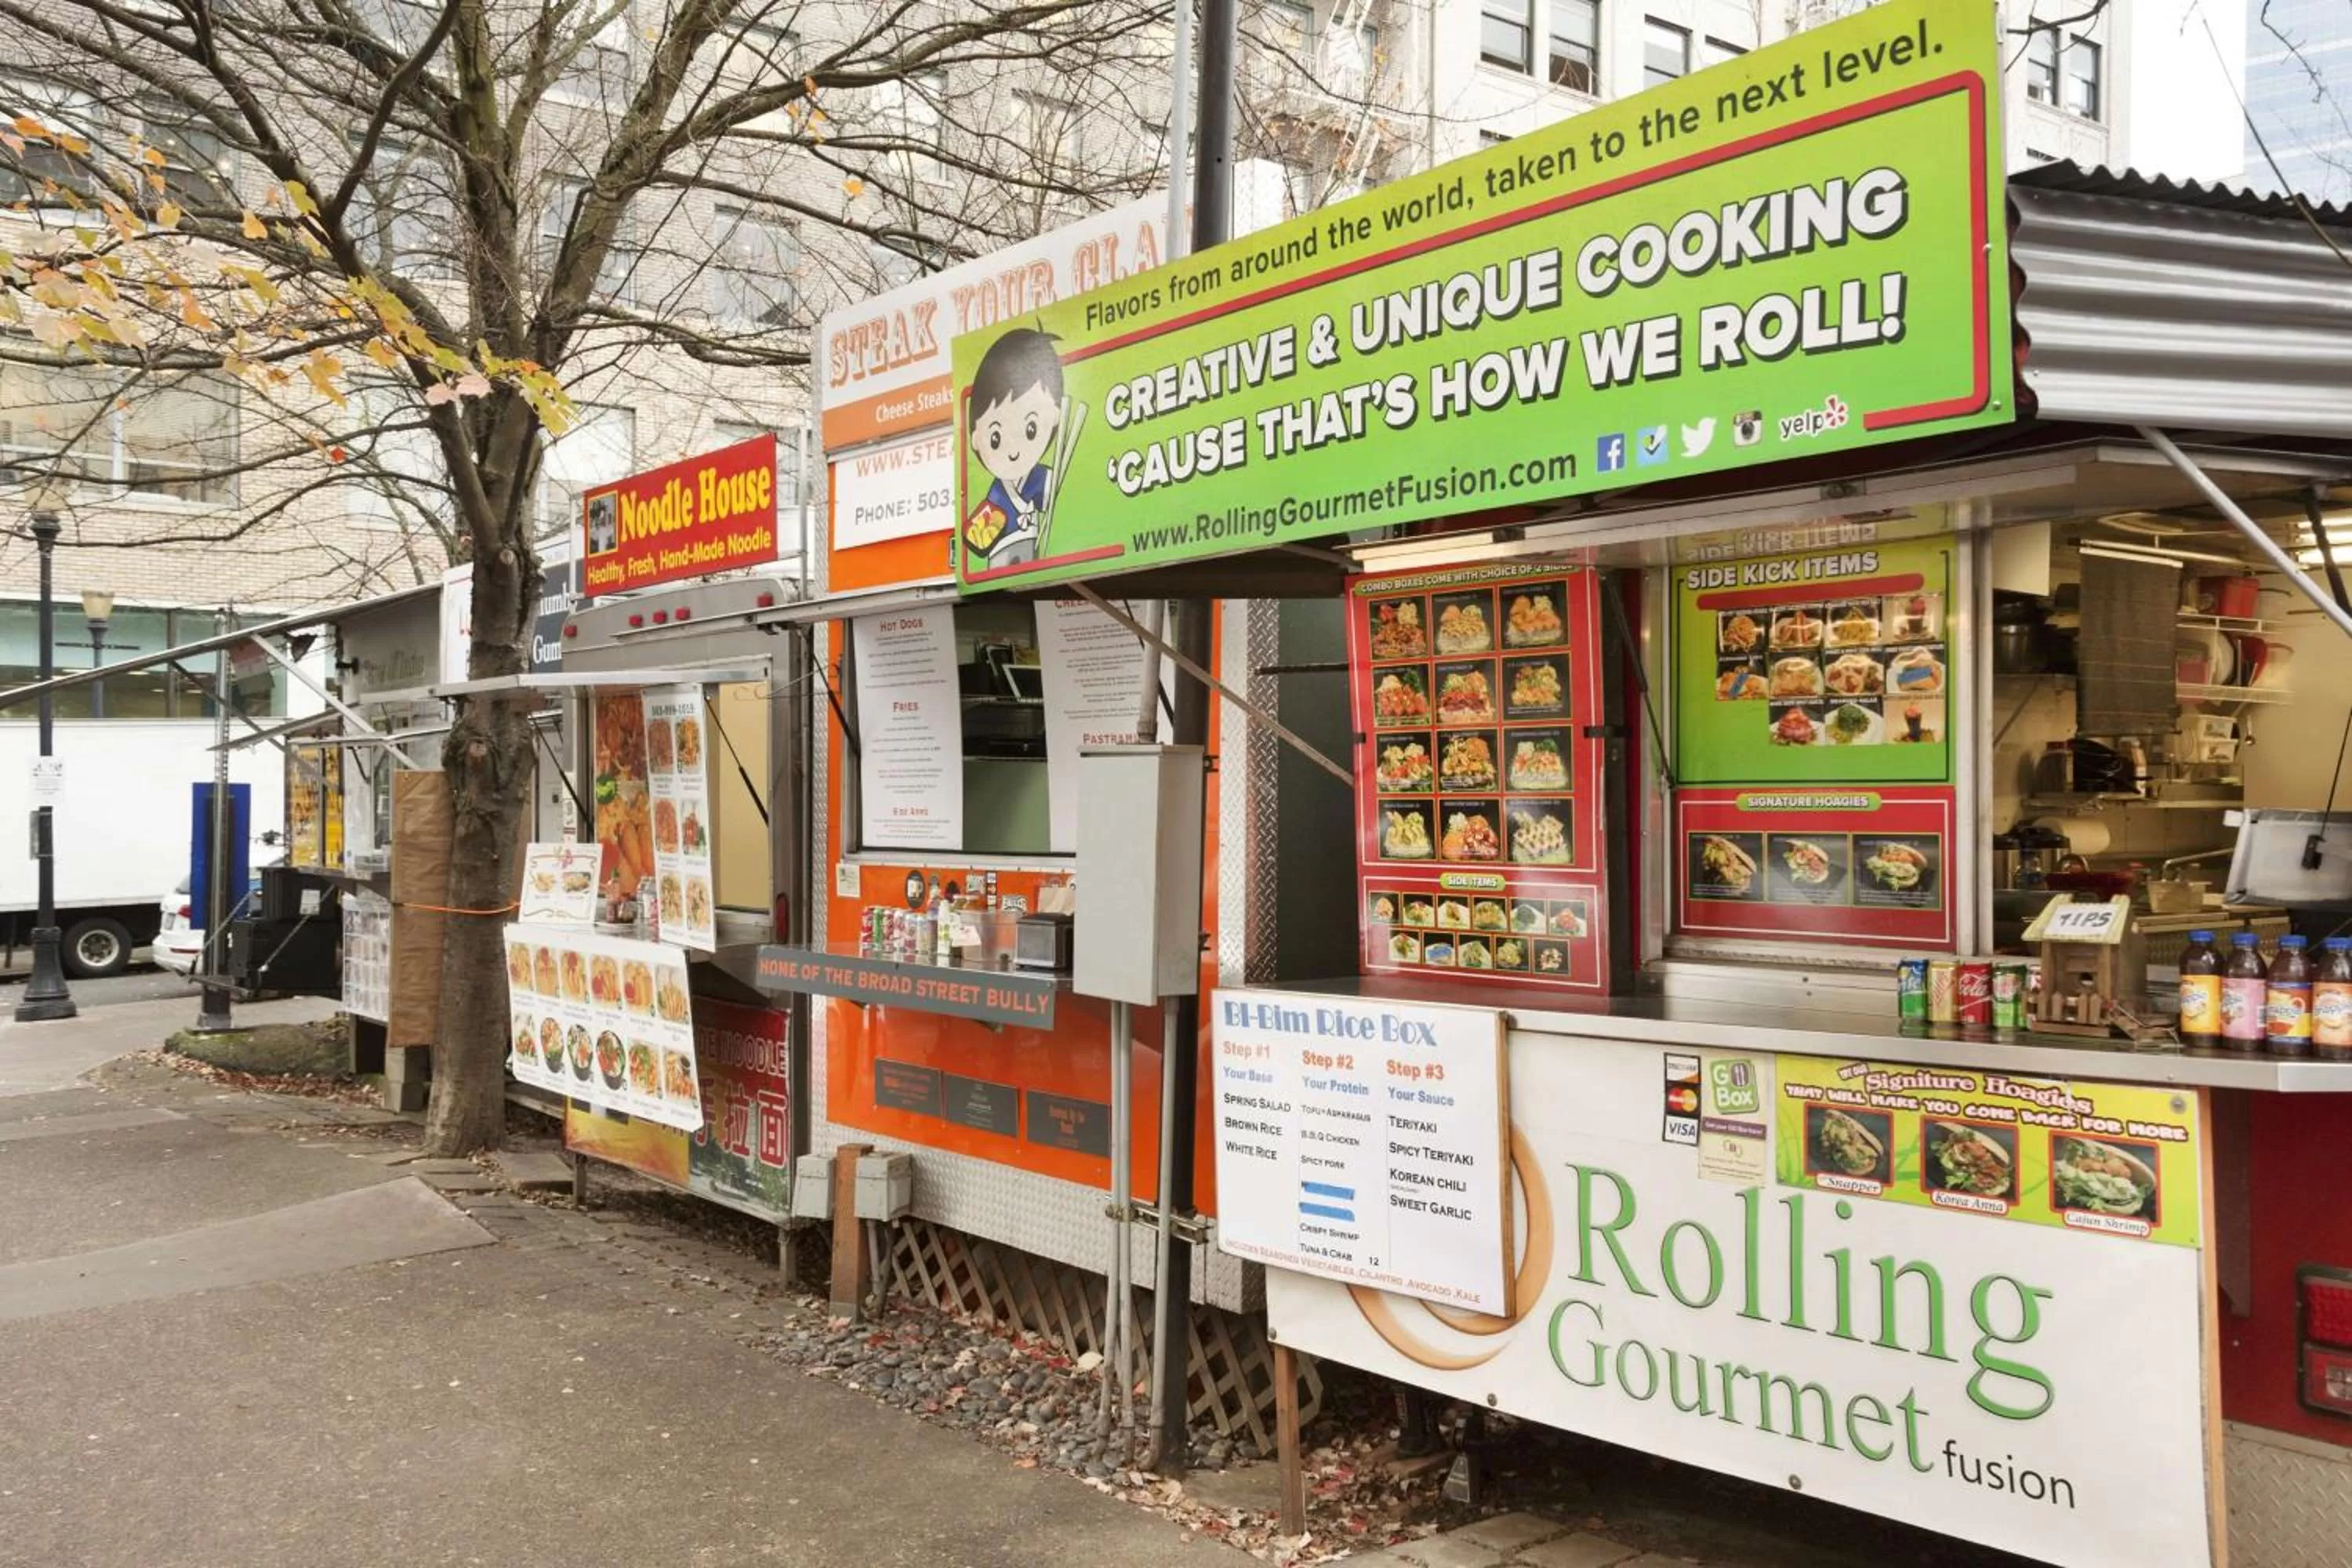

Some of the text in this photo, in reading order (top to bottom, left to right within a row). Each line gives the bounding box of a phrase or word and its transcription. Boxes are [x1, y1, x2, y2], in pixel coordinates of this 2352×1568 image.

[1085, 19, 1944, 331] Flavors from around the world, taken to the next level.
[1105, 167, 1907, 430] CREATIVE & UNIQUE COOKING
[830, 299, 938, 387] STEAK
[951, 257, 1057, 332] YOUR
[1258, 374, 1417, 459] THAT'S
[1431, 337, 1568, 421] HOW
[1581, 314, 1681, 390] WE
[1699, 272, 1907, 370] ROLL!
[876, 399, 914, 423] Cheese
[1780, 412, 1824, 440] yelp
[621, 466, 771, 543] Noodle House
[1132, 453, 1577, 553] www.RollingGourmetFusion.com
[588, 526, 771, 585] Healthy, Fresh, Hand-Made Noodle
[1426, 575, 1452, 586] COME
[1454, 571, 1478, 583] WITH
[1479, 565, 1519, 579] CHOICE
[1687, 551, 1879, 590] SIDE KICK ITEMS
[1748, 796, 1869, 808] SIGNATURE HOAGIES
[2060, 912, 2113, 927] TIPS
[759, 958, 1050, 1015] HOME OF THE BROAD STREET BULLY
[1316, 1009, 1375, 1040] Rice
[1223, 1041, 1271, 1059] Step #1
[1302, 1050, 1354, 1070] Step #2
[1223, 1066, 1247, 1080] Your
[1386, 1059, 1445, 1081] Step #3
[1302, 1076, 1369, 1095] Your Protein
[1388, 1086, 1454, 1106] Your Sauce
[1984, 1076, 2093, 1114] Hoagies
[1785, 1084, 2188, 1142] THAT WILL MAKE YOU COME BACK FOR MORE
[1669, 1123, 1696, 1137] VISA
[1828, 1178, 1879, 1193] Snapper
[1935, 1192, 2004, 1212] Korea Anna
[2067, 1212, 2147, 1236] Cajun Shrimp
[1369, 1257, 1379, 1266] 12
[1566, 1160, 2055, 1421] Rolling
[1547, 1298, 1935, 1475] Gourmet
[1943, 1439, 2076, 1510] fusion
